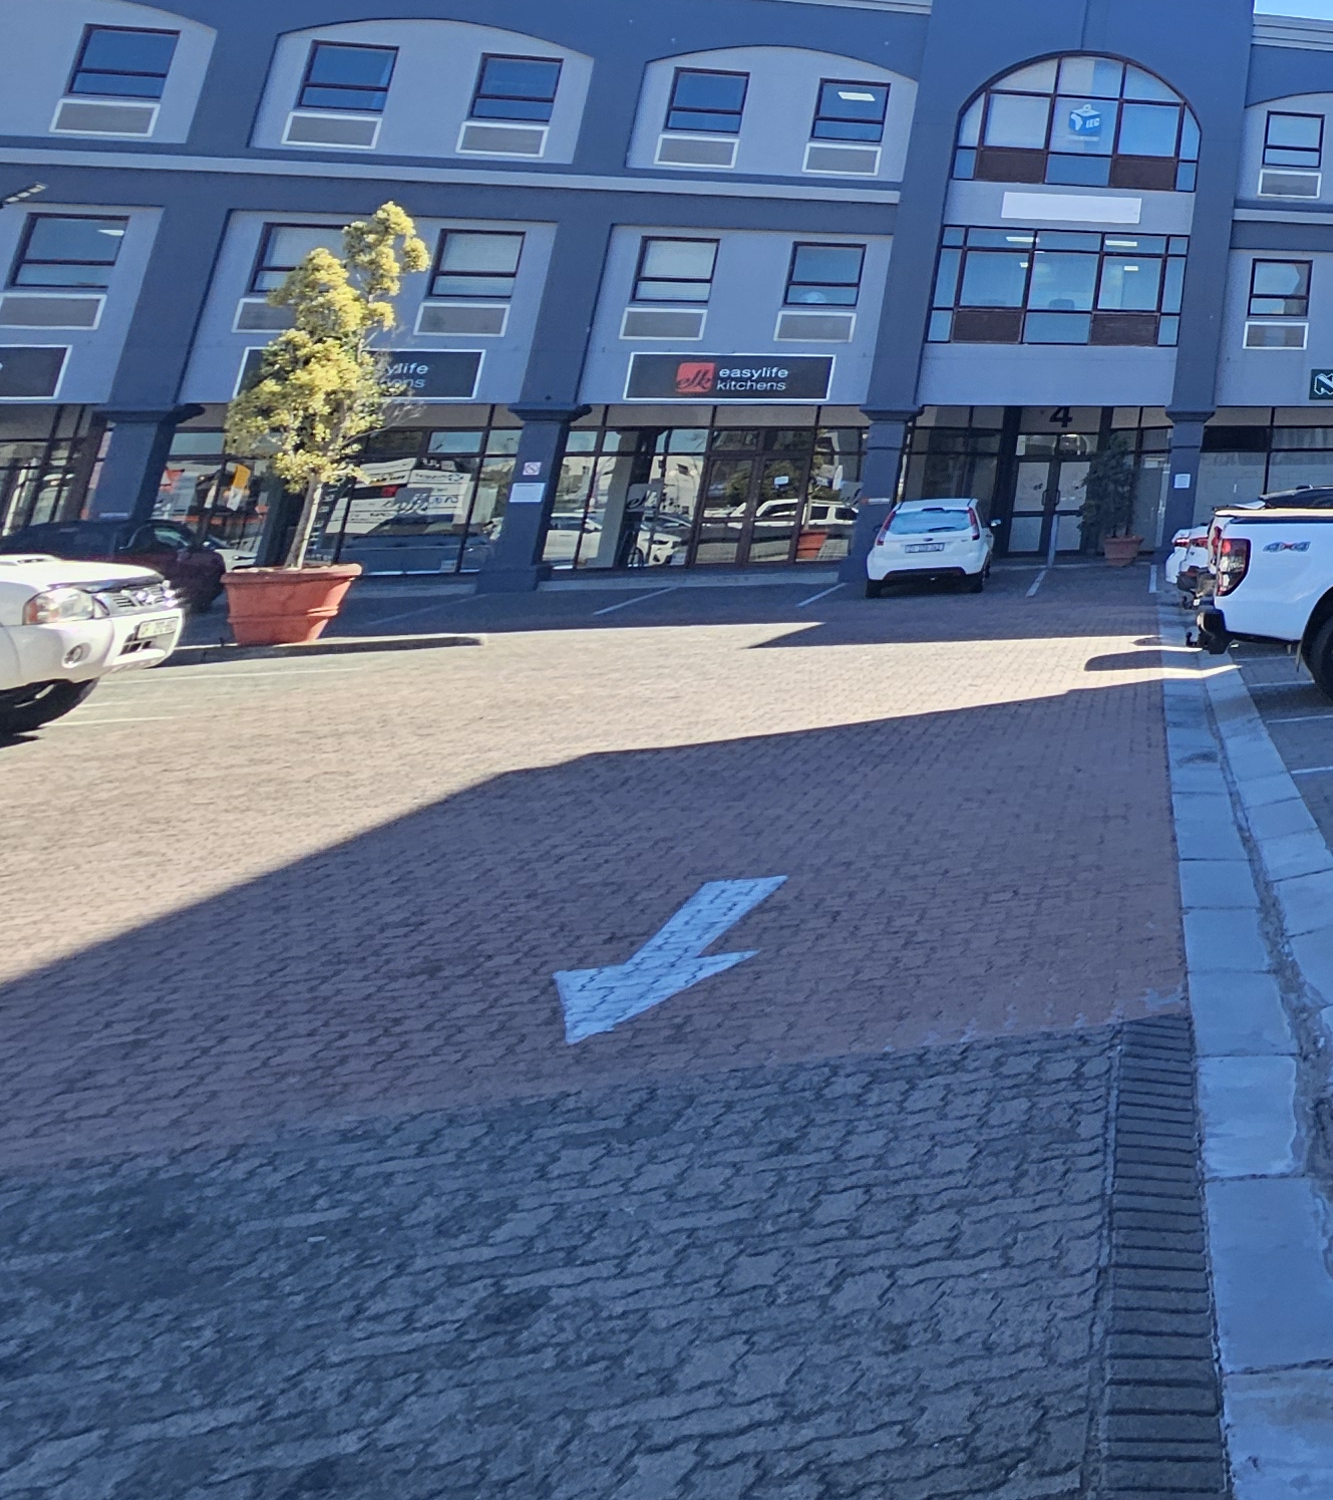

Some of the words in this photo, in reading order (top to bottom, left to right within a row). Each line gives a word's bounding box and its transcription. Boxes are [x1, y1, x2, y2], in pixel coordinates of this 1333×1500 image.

[719, 366, 789, 380] easylife
[716, 380, 787, 391] kitchens
[1049, 406, 1073, 428] 4
